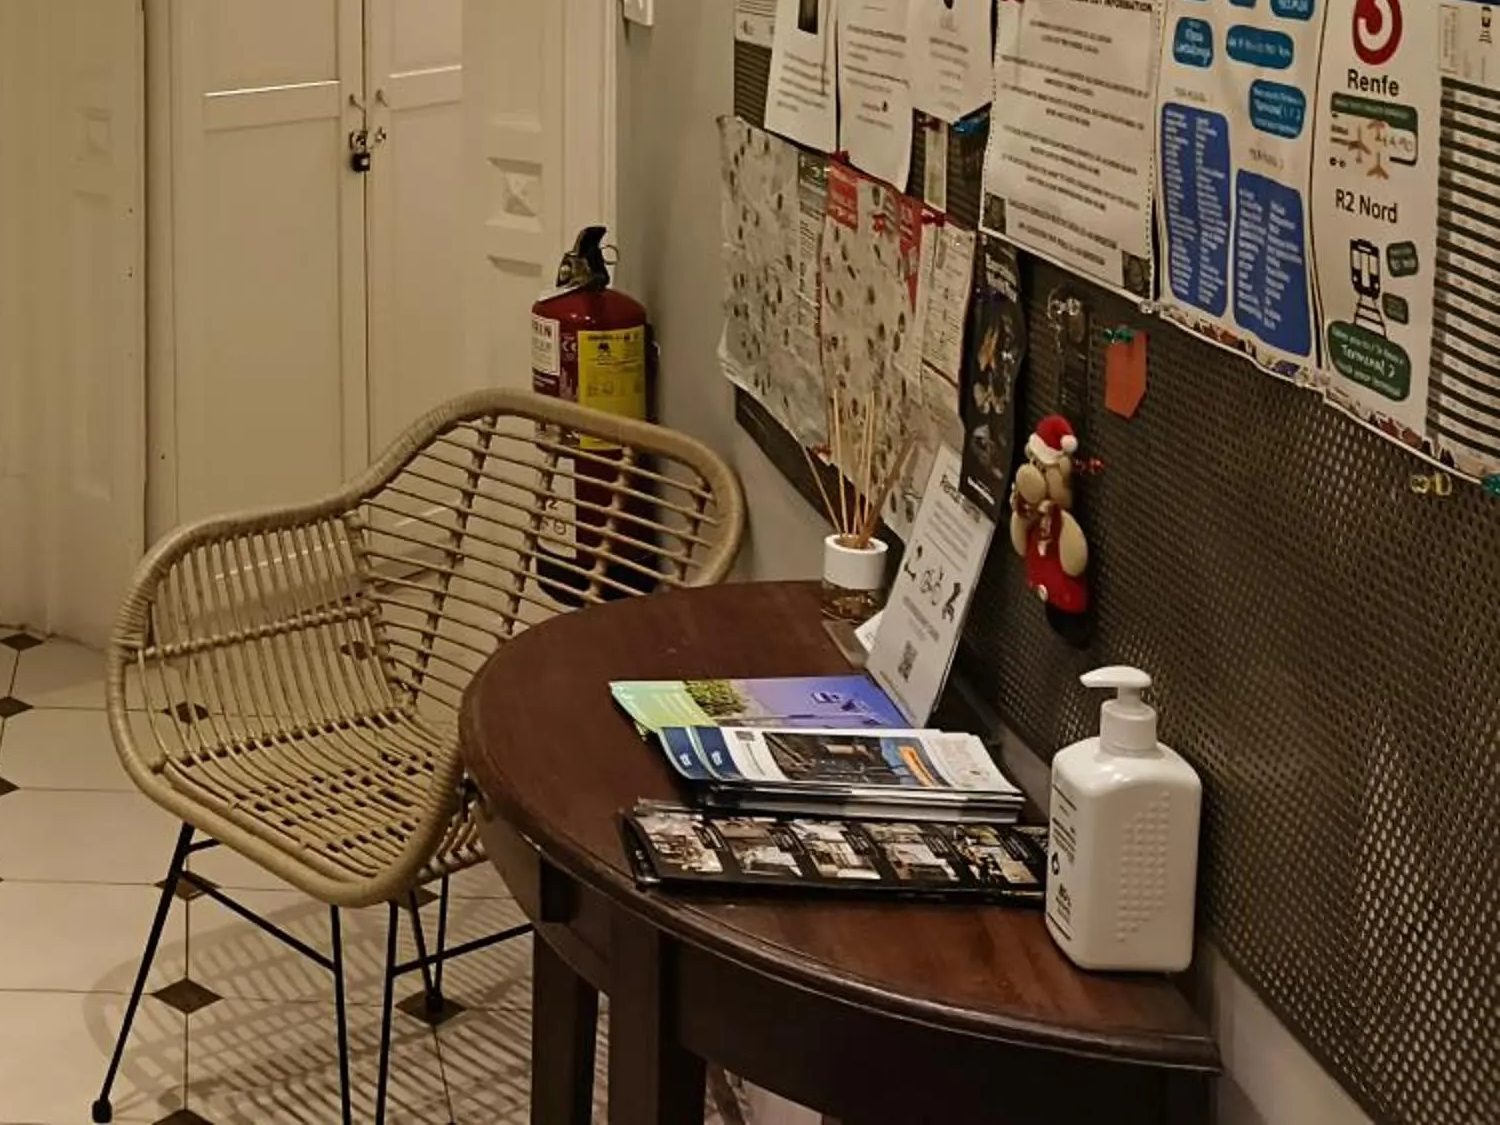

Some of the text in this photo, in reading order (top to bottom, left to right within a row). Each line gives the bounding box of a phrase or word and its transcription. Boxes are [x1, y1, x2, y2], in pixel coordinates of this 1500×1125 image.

[1347, 68, 1400, 98] Renfe
[1335, 188, 1399, 225] R2 Nord
